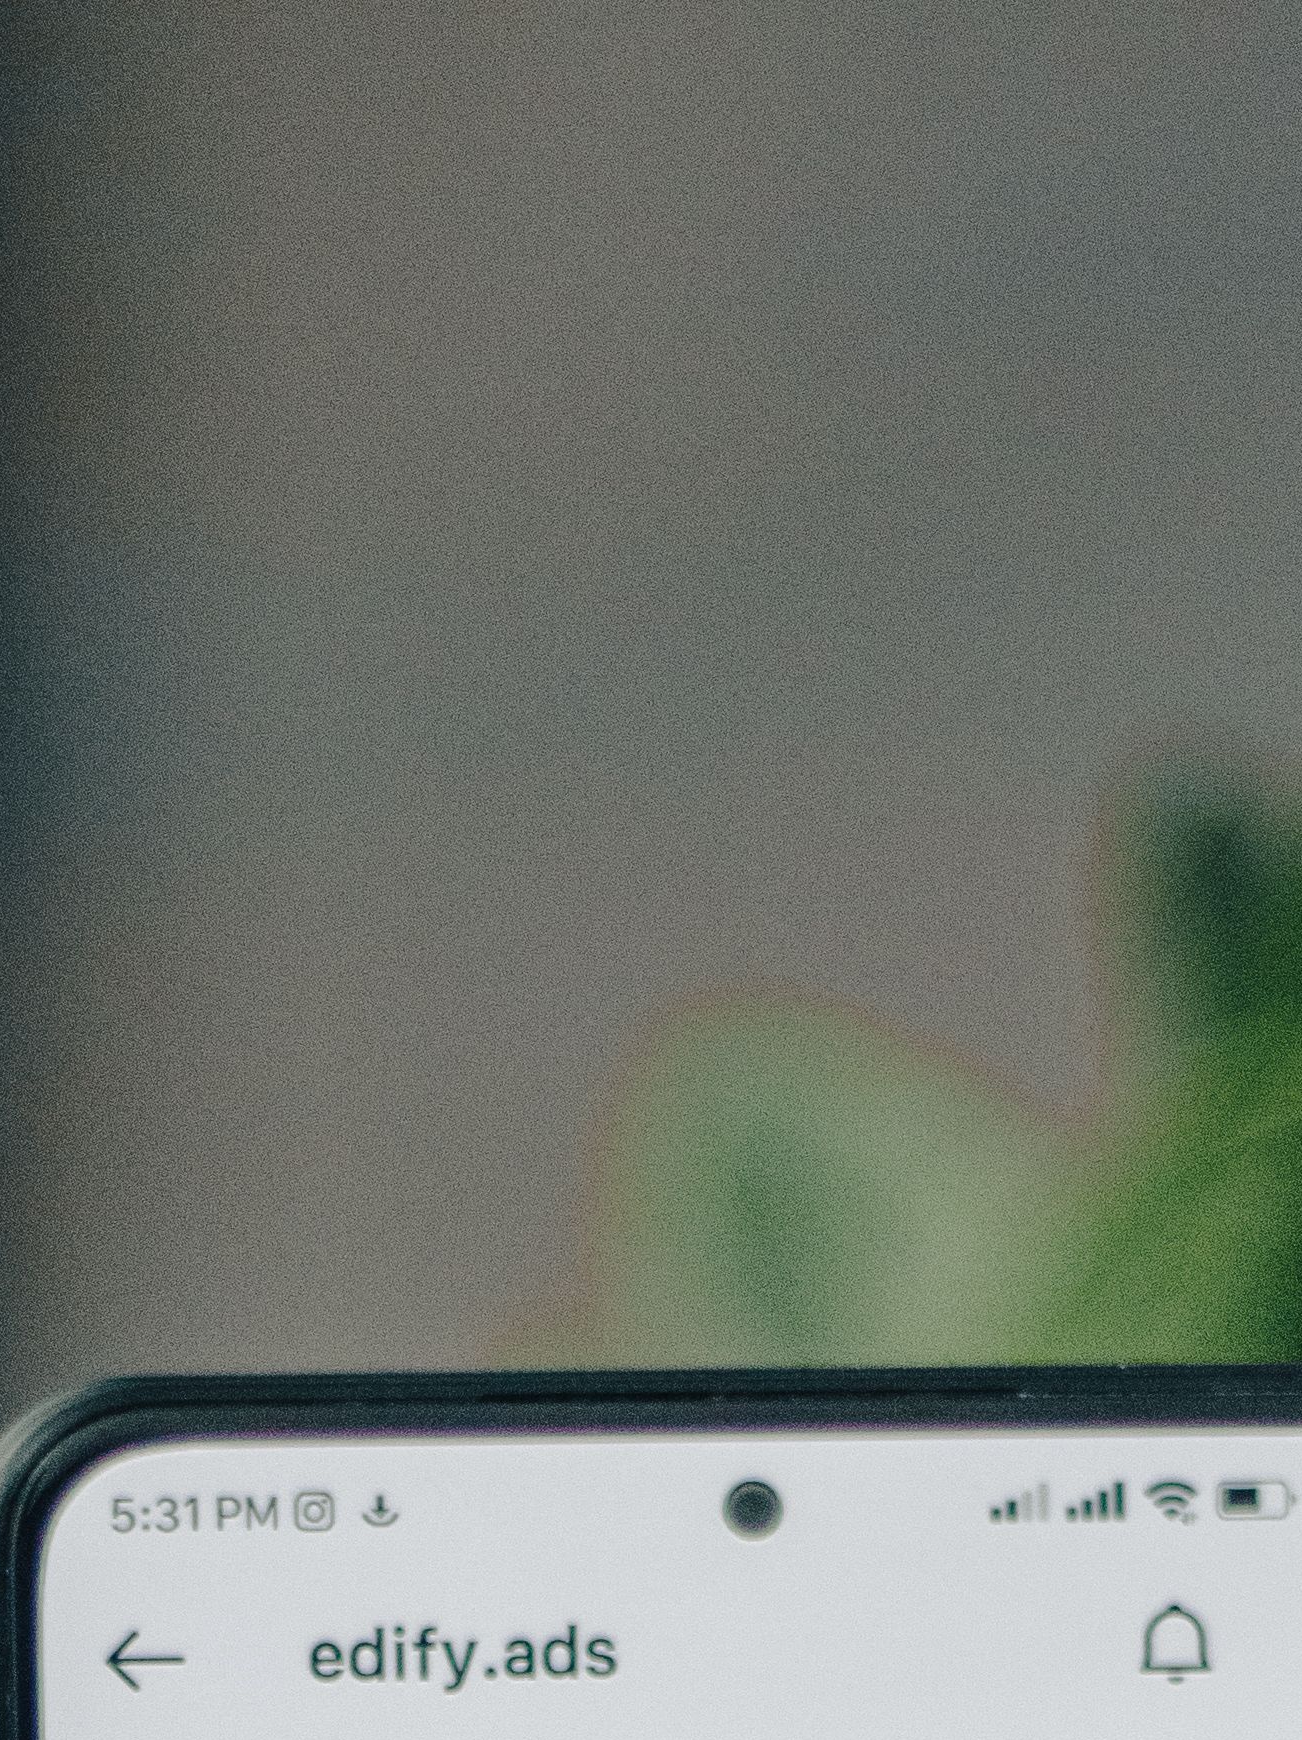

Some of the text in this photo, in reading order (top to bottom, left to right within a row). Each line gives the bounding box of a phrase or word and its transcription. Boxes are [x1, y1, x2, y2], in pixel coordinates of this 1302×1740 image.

[111, 1494, 279, 1534] 5:31 PM
[309, 1624, 617, 1692] edify.ads
